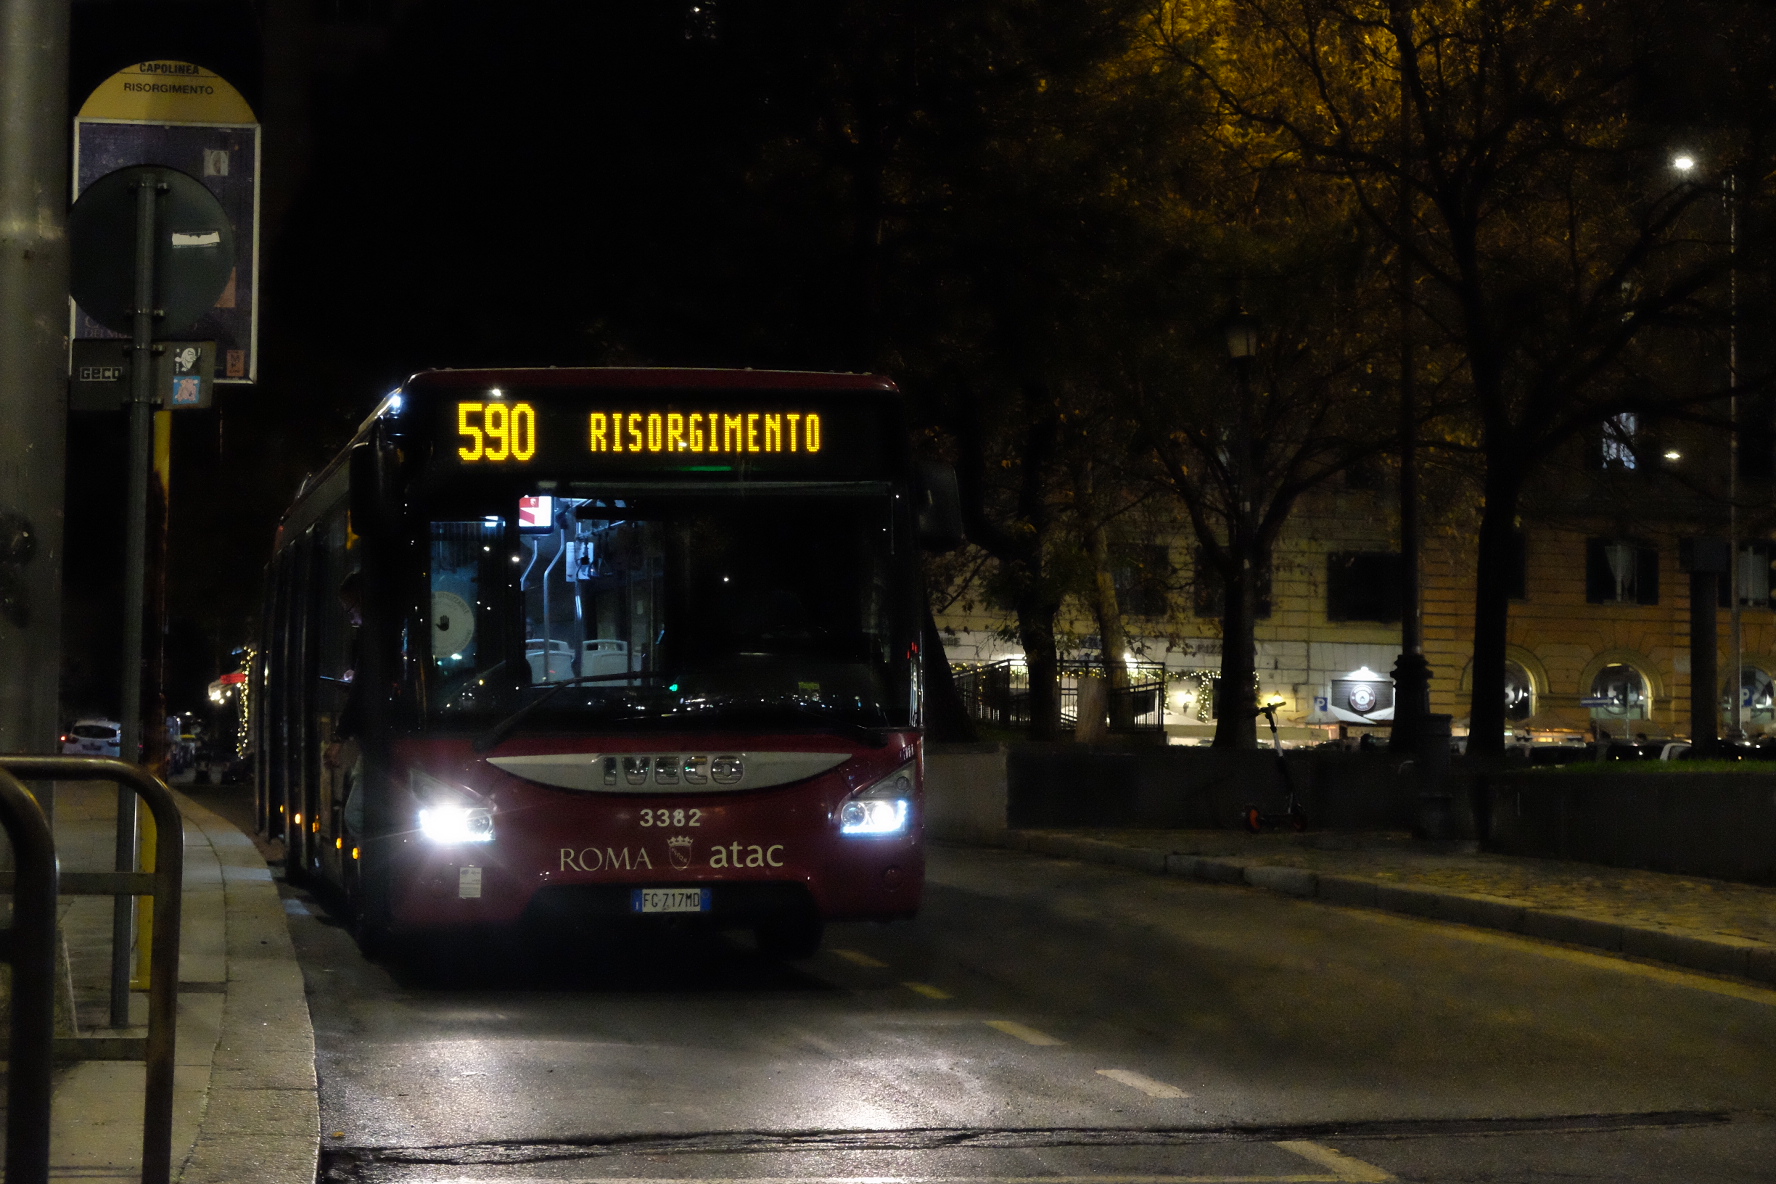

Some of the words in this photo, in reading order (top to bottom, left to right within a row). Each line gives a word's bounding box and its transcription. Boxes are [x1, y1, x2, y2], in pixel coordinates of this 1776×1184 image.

[139, 62, 199, 75] CAPOLINEA
[123, 82, 214, 95] RISORGIMENTO
[457, 401, 536, 462] 590
[589, 412, 822, 453] RISORGIMENTO
[603, 755, 744, 786] IVECO
[639, 808, 701, 827] 3382
[559, 846, 653, 871] ROMA
[709, 840, 784, 868] atac
